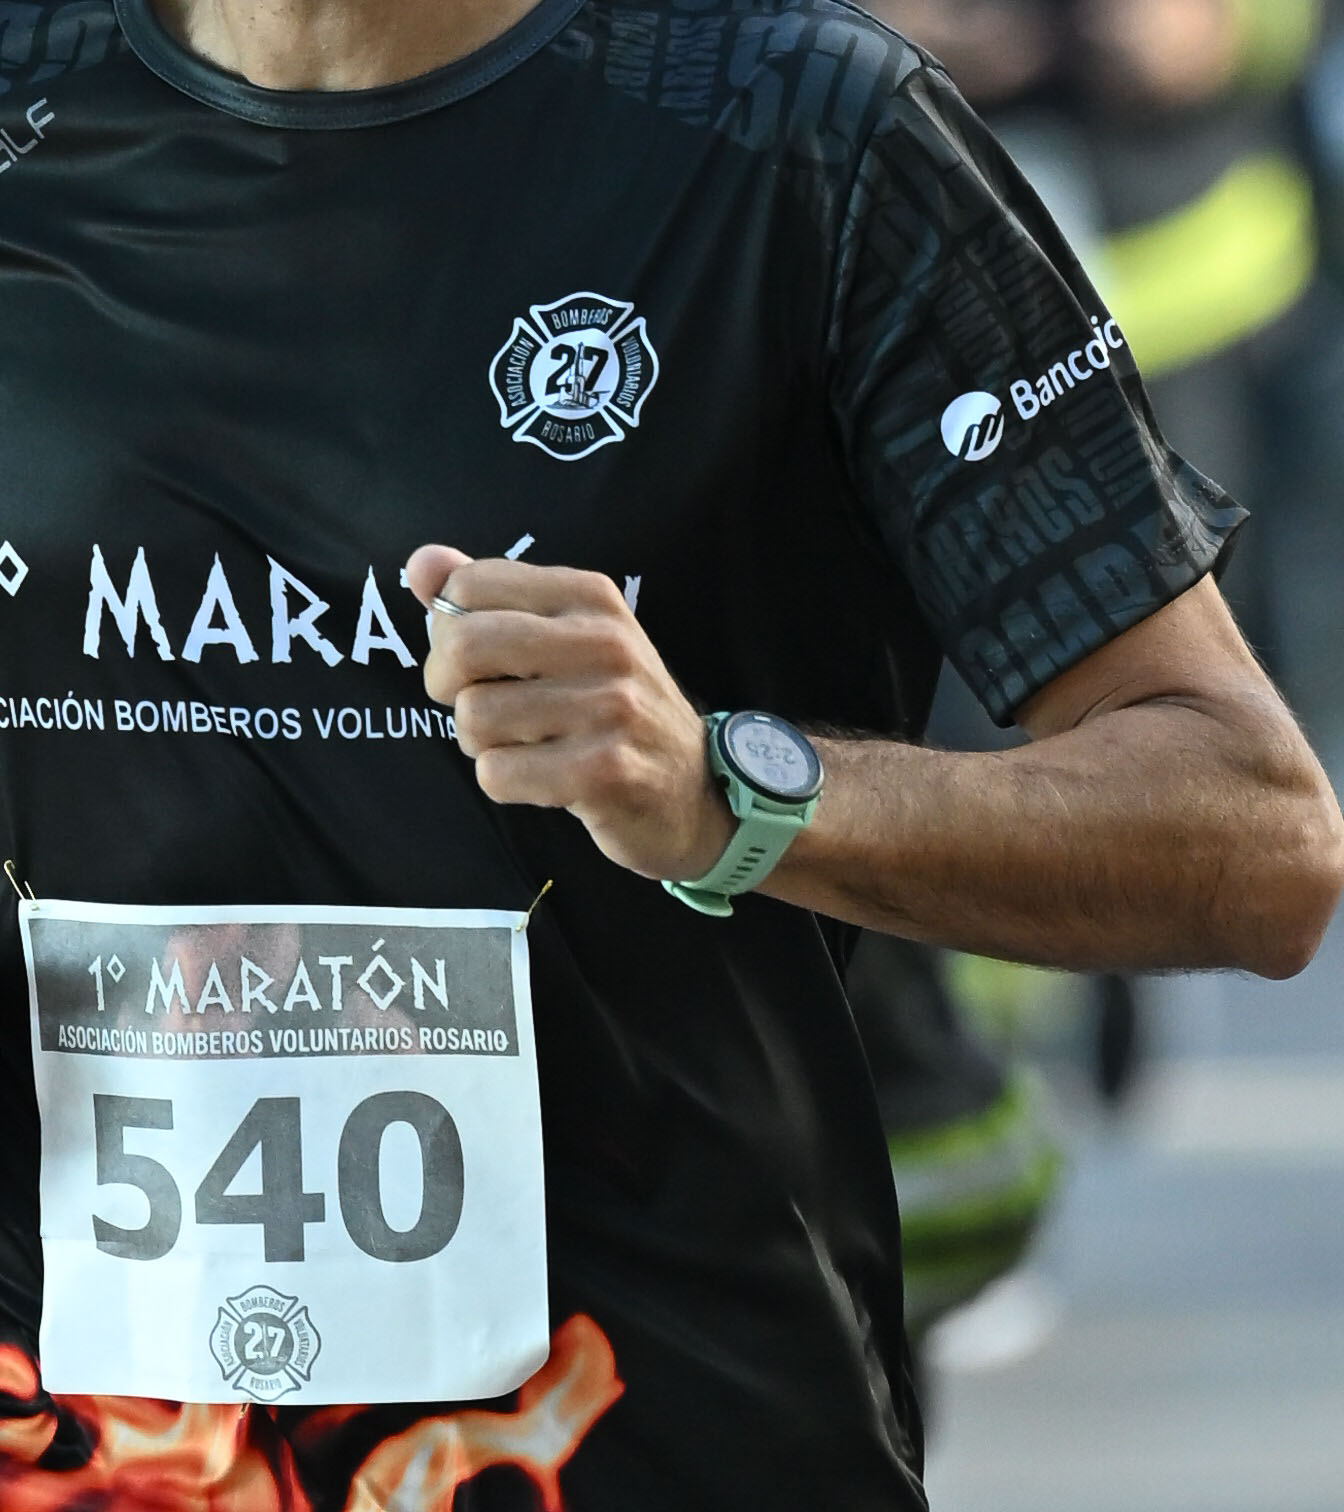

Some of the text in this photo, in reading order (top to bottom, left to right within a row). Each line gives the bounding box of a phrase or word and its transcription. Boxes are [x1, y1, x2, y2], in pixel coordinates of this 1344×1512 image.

[551, 308, 613, 329] BOMBEROS
[506, 337, 535, 407] ASOCIACIÓN
[544, 343, 609, 396] 27
[540, 420, 596, 443] ROSARIO
[83, 533, 642, 667] MARA
[114, 700, 302, 740] BOMBEROS
[145, 938, 449, 1014] MARATÓN
[58, 1024, 507, 1056] ASOCIACIÓN BOMBEROS VOLUNTARIOS ROSARIO
[92, 1090, 465, 1264] 540
[243, 1321, 286, 1360] 27
